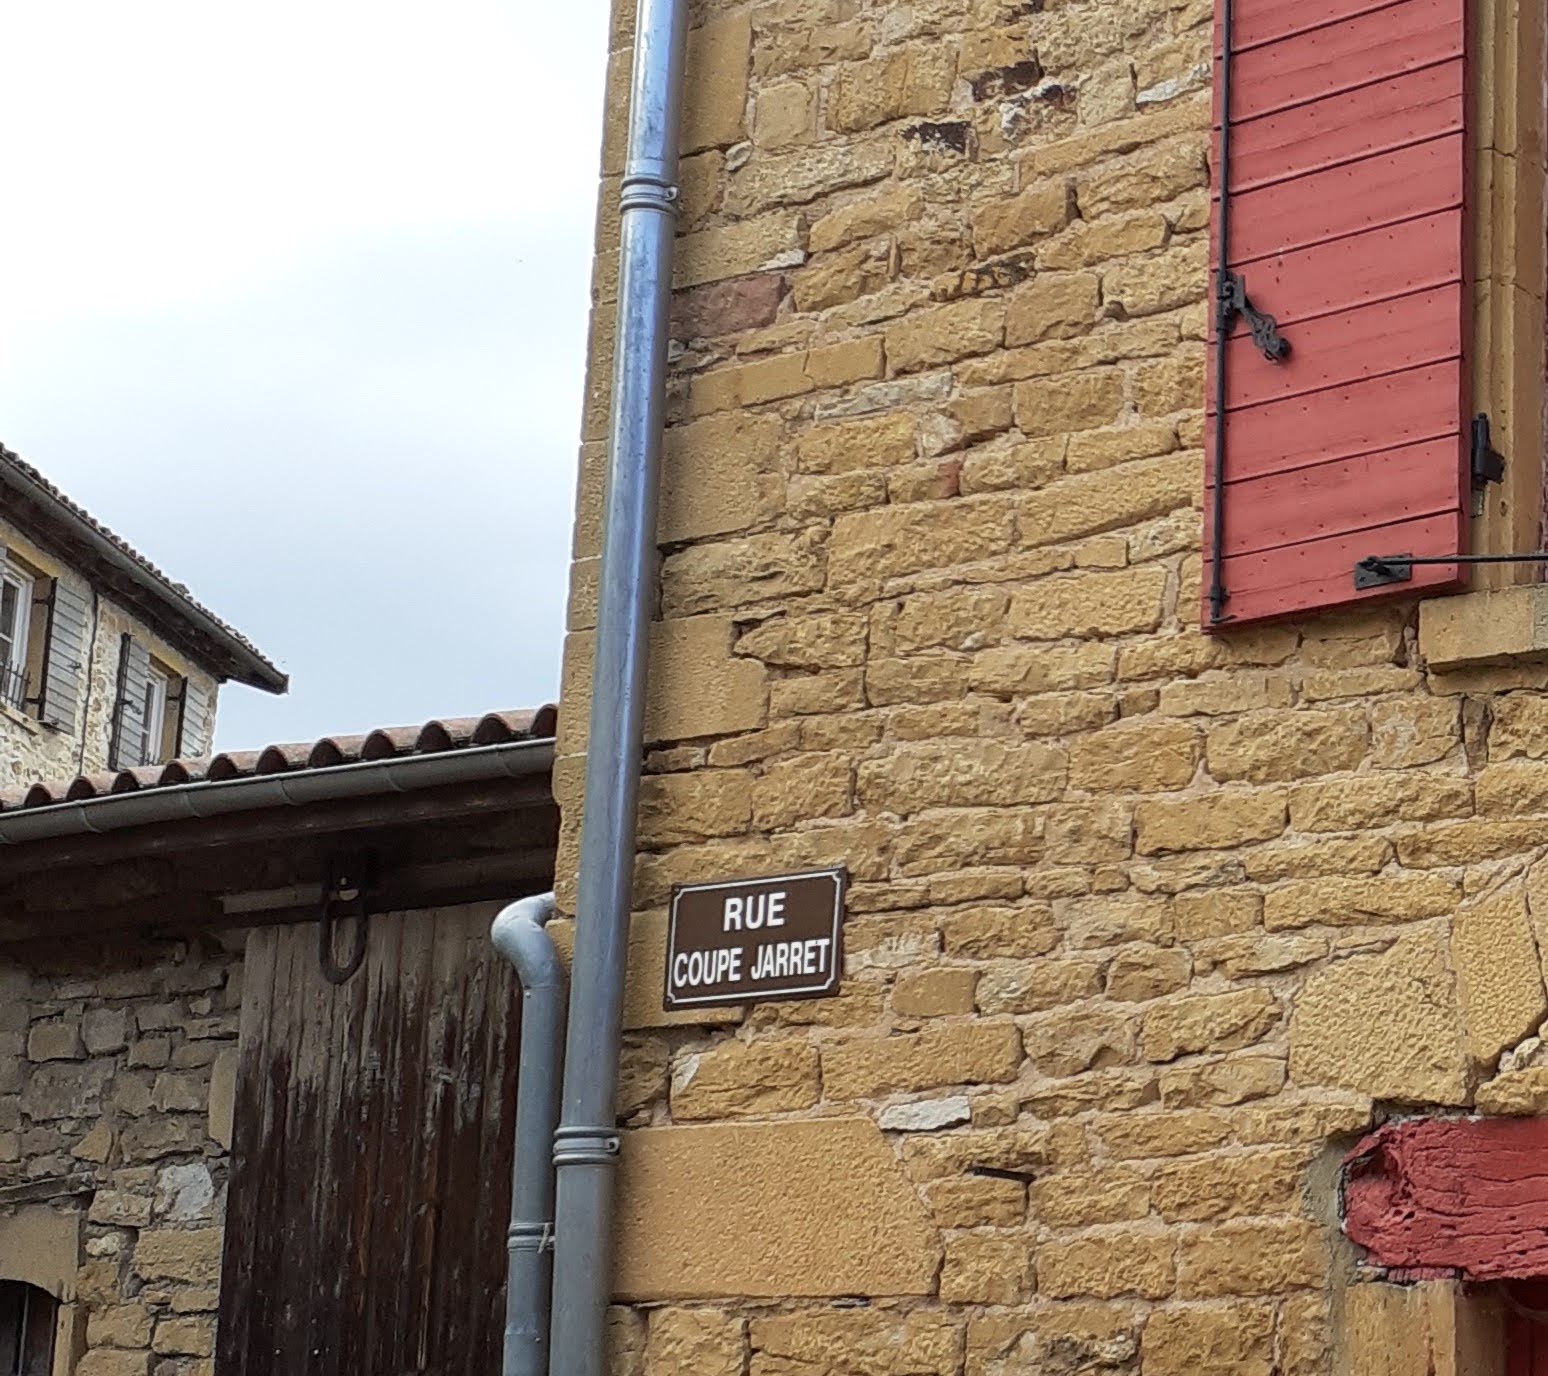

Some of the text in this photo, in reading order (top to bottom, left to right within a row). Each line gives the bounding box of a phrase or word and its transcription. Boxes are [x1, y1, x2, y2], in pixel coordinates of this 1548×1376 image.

[723, 891, 786, 932] RUE
[673, 938, 830, 988] COUPE JARRET
